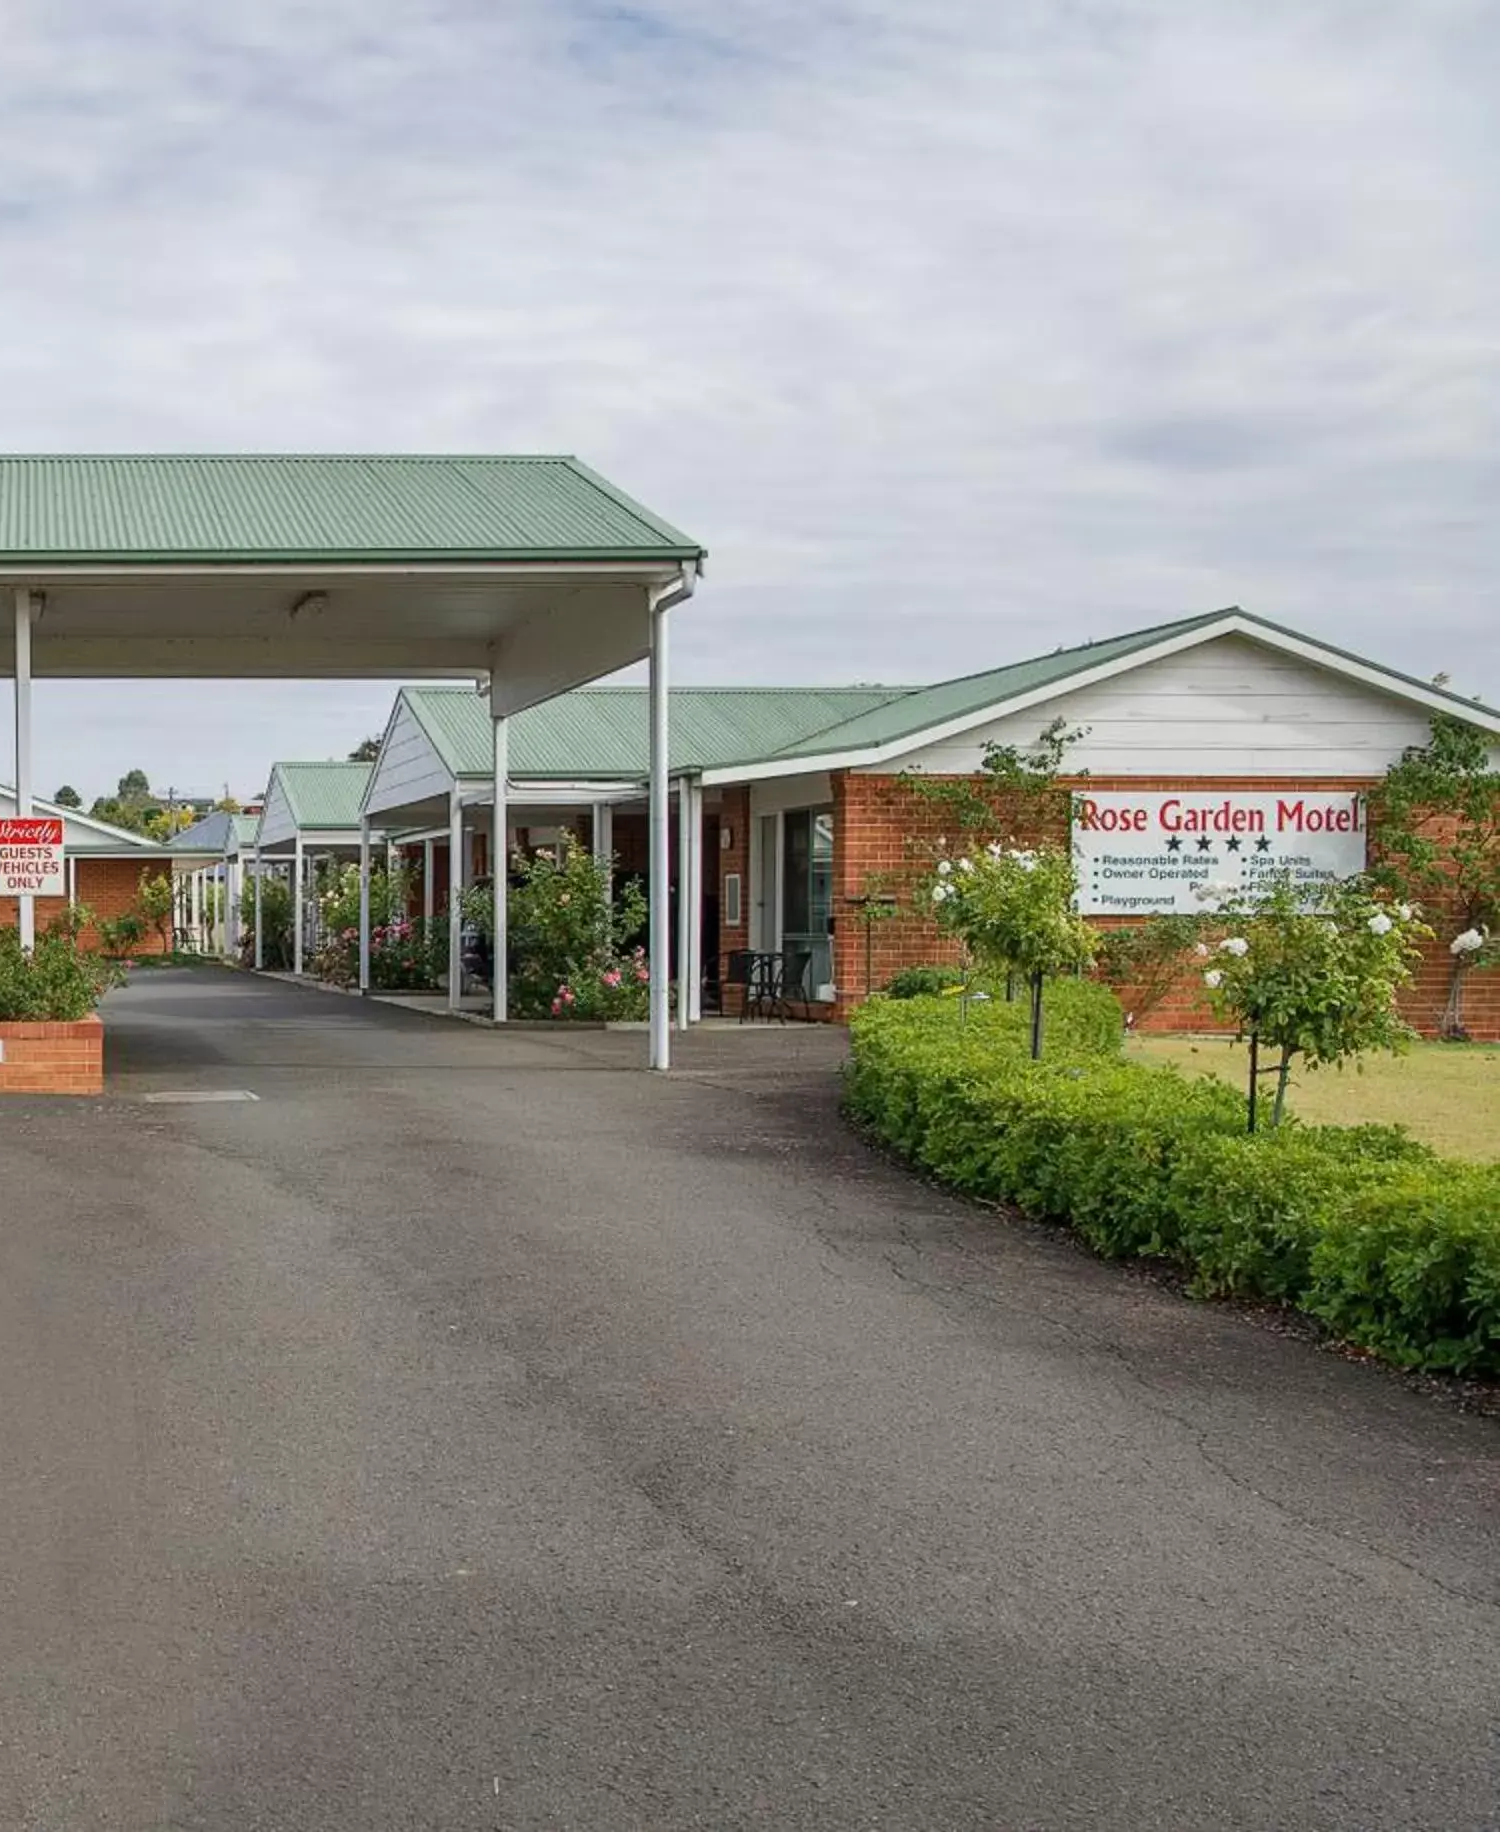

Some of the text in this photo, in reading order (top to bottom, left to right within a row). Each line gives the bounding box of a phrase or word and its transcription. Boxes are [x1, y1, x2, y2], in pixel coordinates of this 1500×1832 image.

[1080, 798, 1359, 832] Rose Garden Motel
[0, 847, 53, 859] GUESTS
[1102, 854, 1219, 866] Reasonable Rates
[1250, 855, 1275, 867] Spa
[1102, 867, 1209, 881] Owner Operated
[7, 876, 44, 889] ONLY
[1101, 894, 1175, 908] Playground
